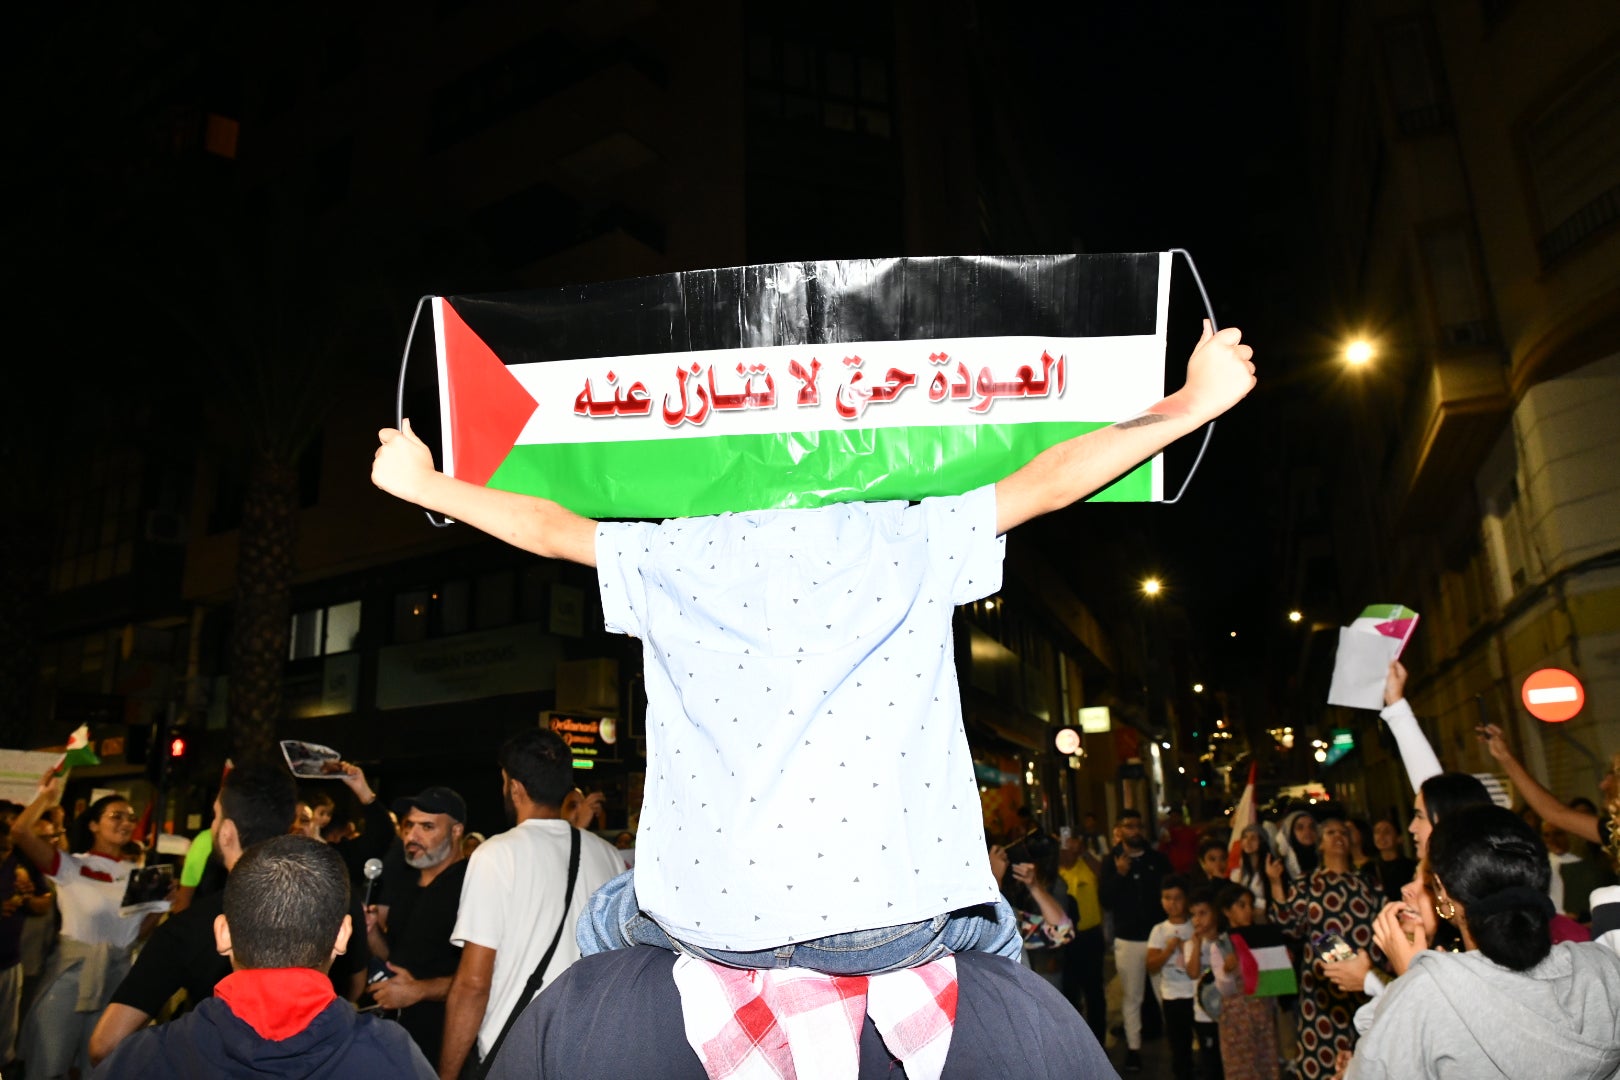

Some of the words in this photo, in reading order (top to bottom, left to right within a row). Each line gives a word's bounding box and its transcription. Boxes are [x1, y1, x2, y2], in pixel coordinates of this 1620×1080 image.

[572, 369, 652, 417] عنه
[661, 360, 777, 426] تنازل
[787, 356, 822, 405] لا
[834, 354, 917, 419] حق
[928, 349, 1065, 412] العودة
